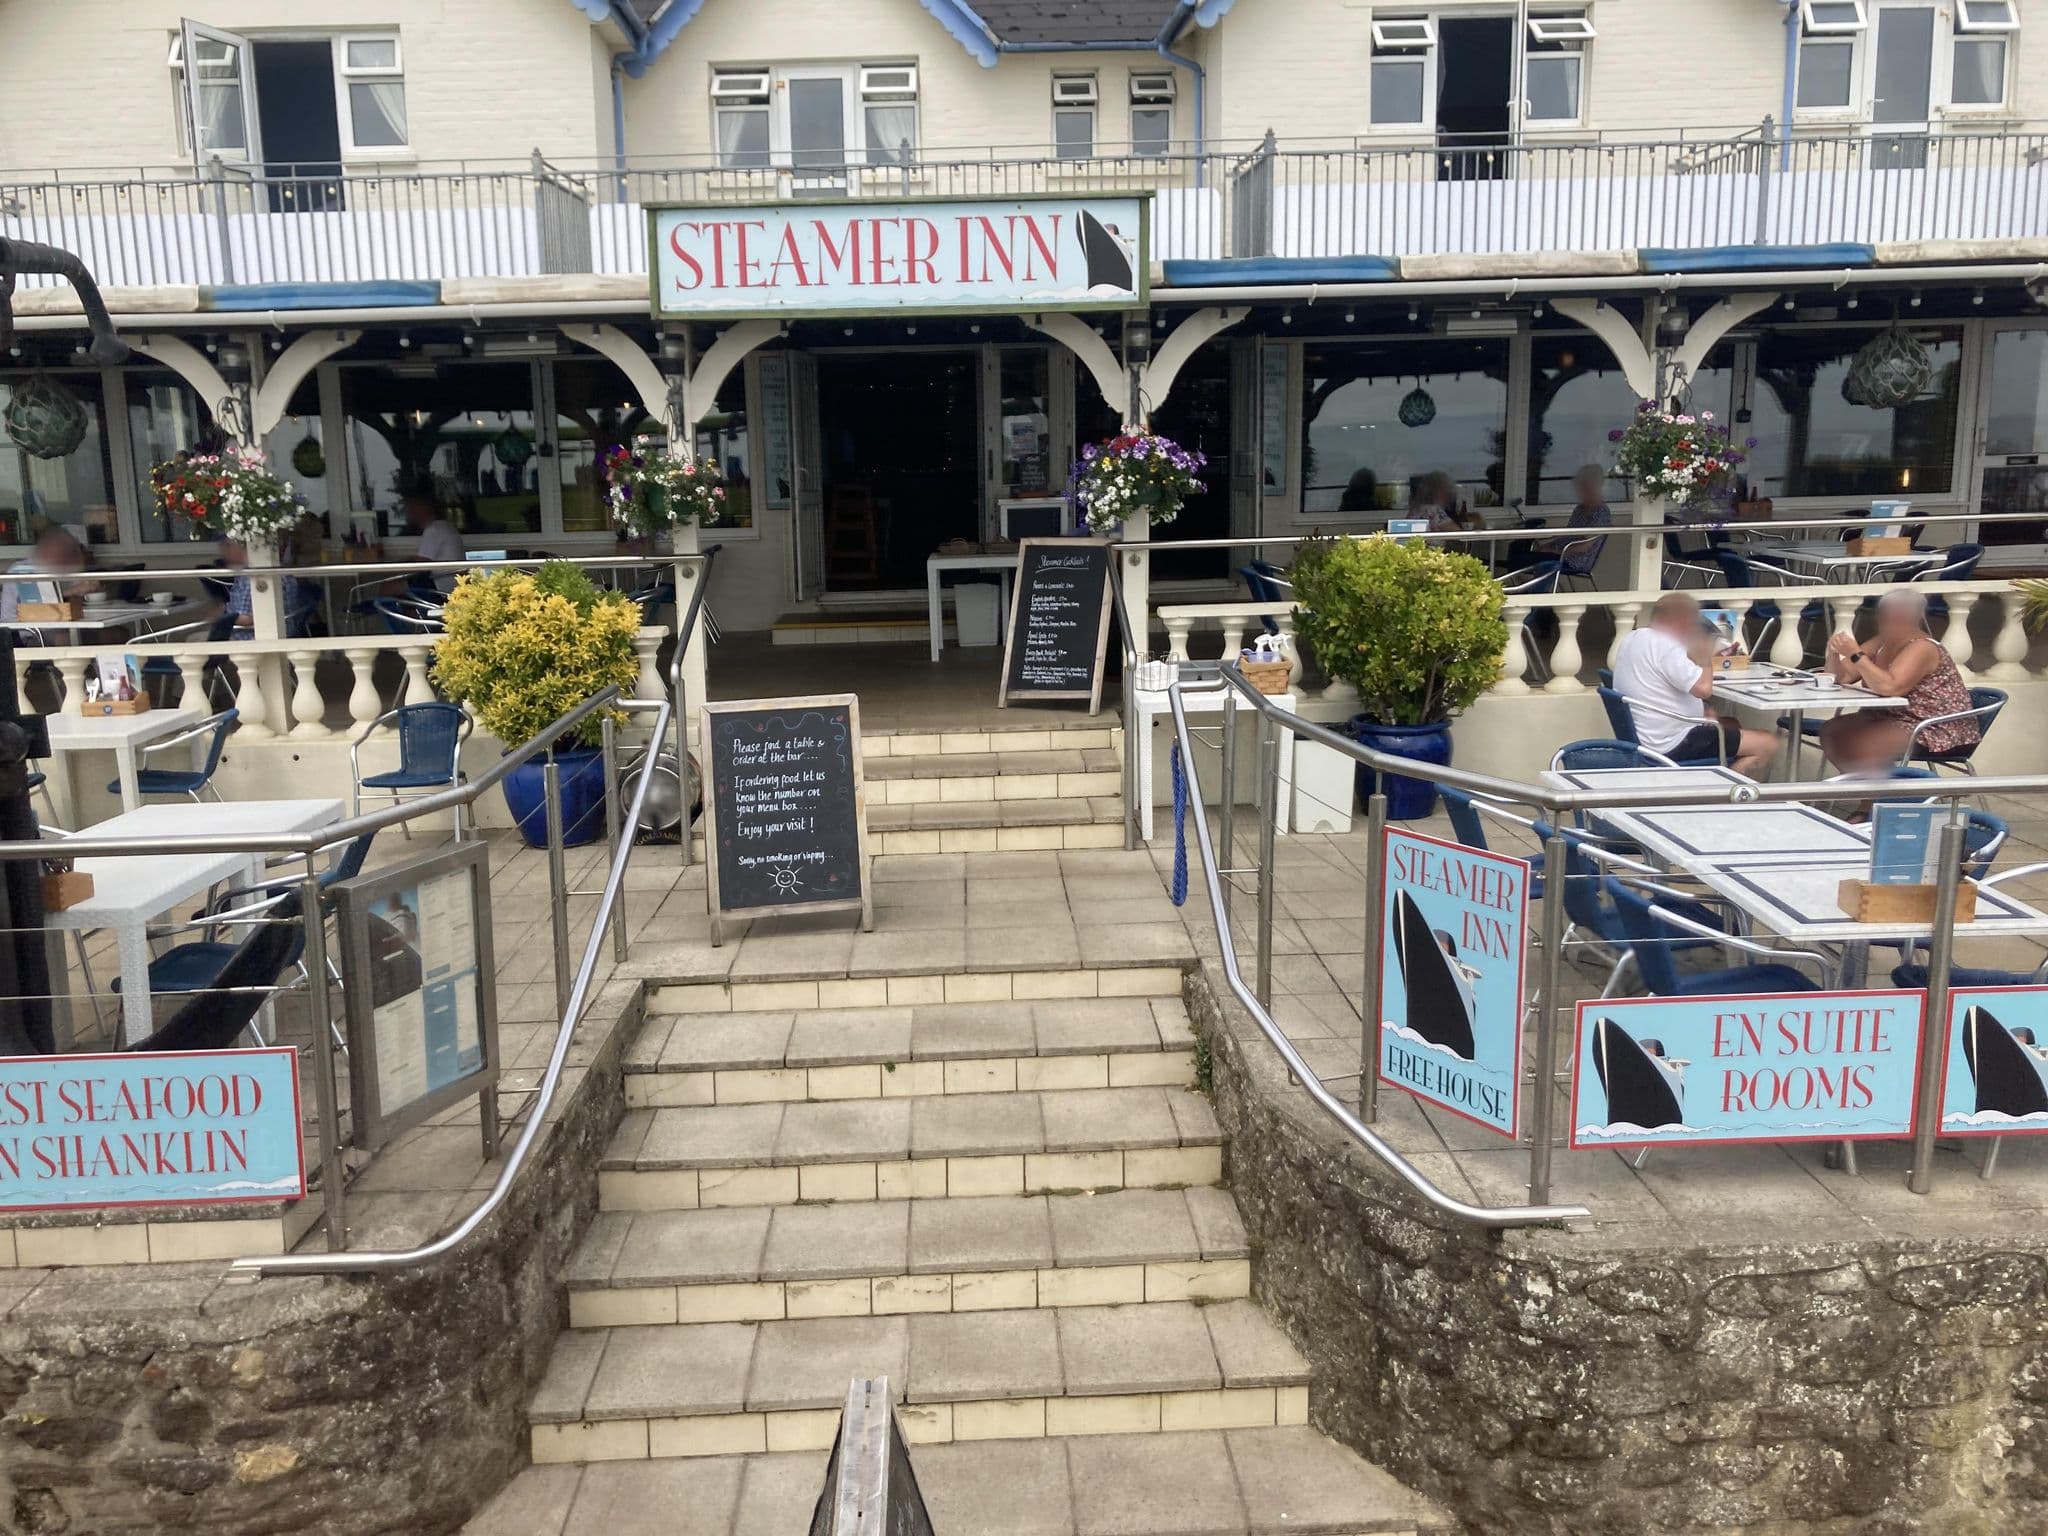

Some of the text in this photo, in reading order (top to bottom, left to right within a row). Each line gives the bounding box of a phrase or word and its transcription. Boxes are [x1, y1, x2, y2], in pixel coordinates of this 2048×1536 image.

[670, 215, 1063, 292] STEAMER INN
[732, 755, 757, 766] order
[758, 754, 767, 763] at
[770, 752, 784, 763] the
[733, 738, 760, 753] Please
[763, 736, 780, 756] find
[794, 737, 814, 748] table
[734, 770, 825, 791] If ordering food let us
[735, 788, 820, 803] know the number on
[736, 804, 756, 818] your
[758, 803, 779, 812] menu
[738, 821, 762, 839] Enjoy
[765, 822, 785, 839] your
[786, 817, 806, 831] visit
[766, 851, 792, 866] smoking
[793, 852, 802, 860] or
[1393, 843, 1514, 913] STEAMER
[1461, 910, 1513, 961] INN
[1711, 1007, 1896, 1058] EN SUITE
[58, 1073, 262, 1123] SEAFOOD
[1387, 1045, 1507, 1123] FREE HOUSE
[1719, 1064, 1876, 1113] ROOMS
[32, 1129, 248, 1181] SHANKLIN
